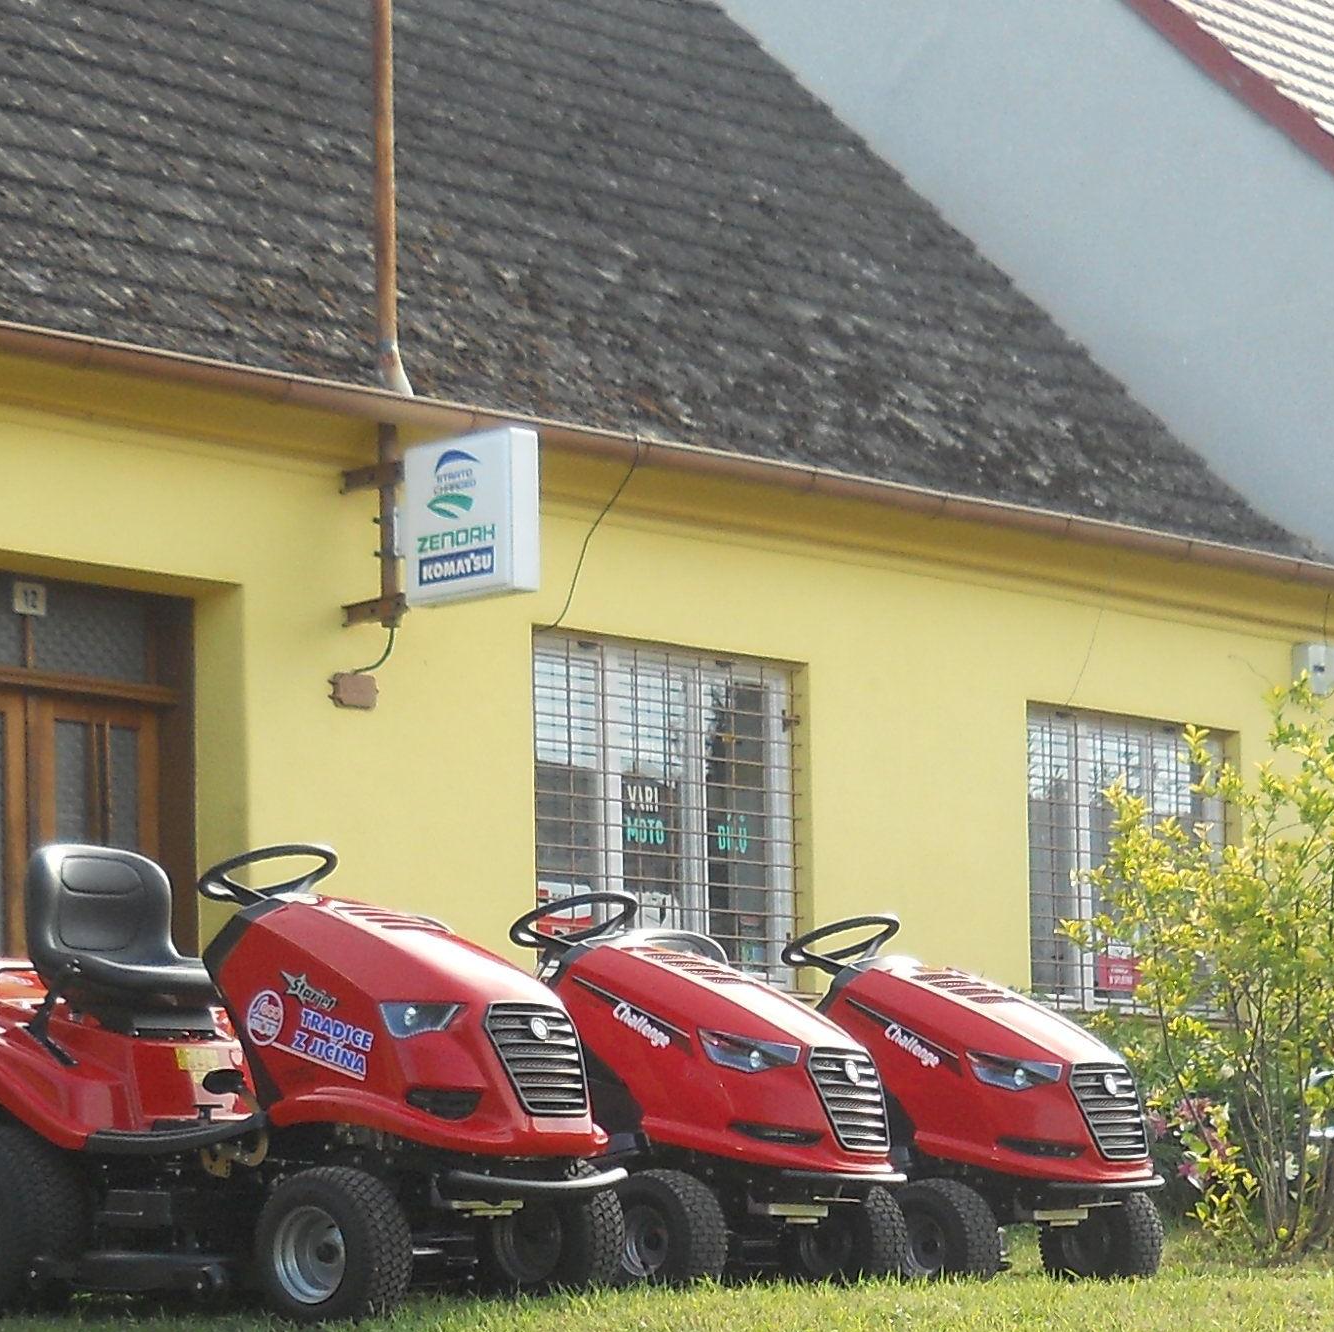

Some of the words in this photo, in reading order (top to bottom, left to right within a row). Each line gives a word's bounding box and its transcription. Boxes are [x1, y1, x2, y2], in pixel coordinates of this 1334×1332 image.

[422, 553, 492, 582] KOMATSU
[22, 590, 38, 608] 12
[626, 784, 660, 812] VARI
[625, 817, 666, 845] MOTO
[301, 1009, 373, 1051] TRADICE
[612, 1002, 670, 1048] Challenge
[293, 1031, 309, 1050] Z
[884, 1022, 941, 1068] Challenge
